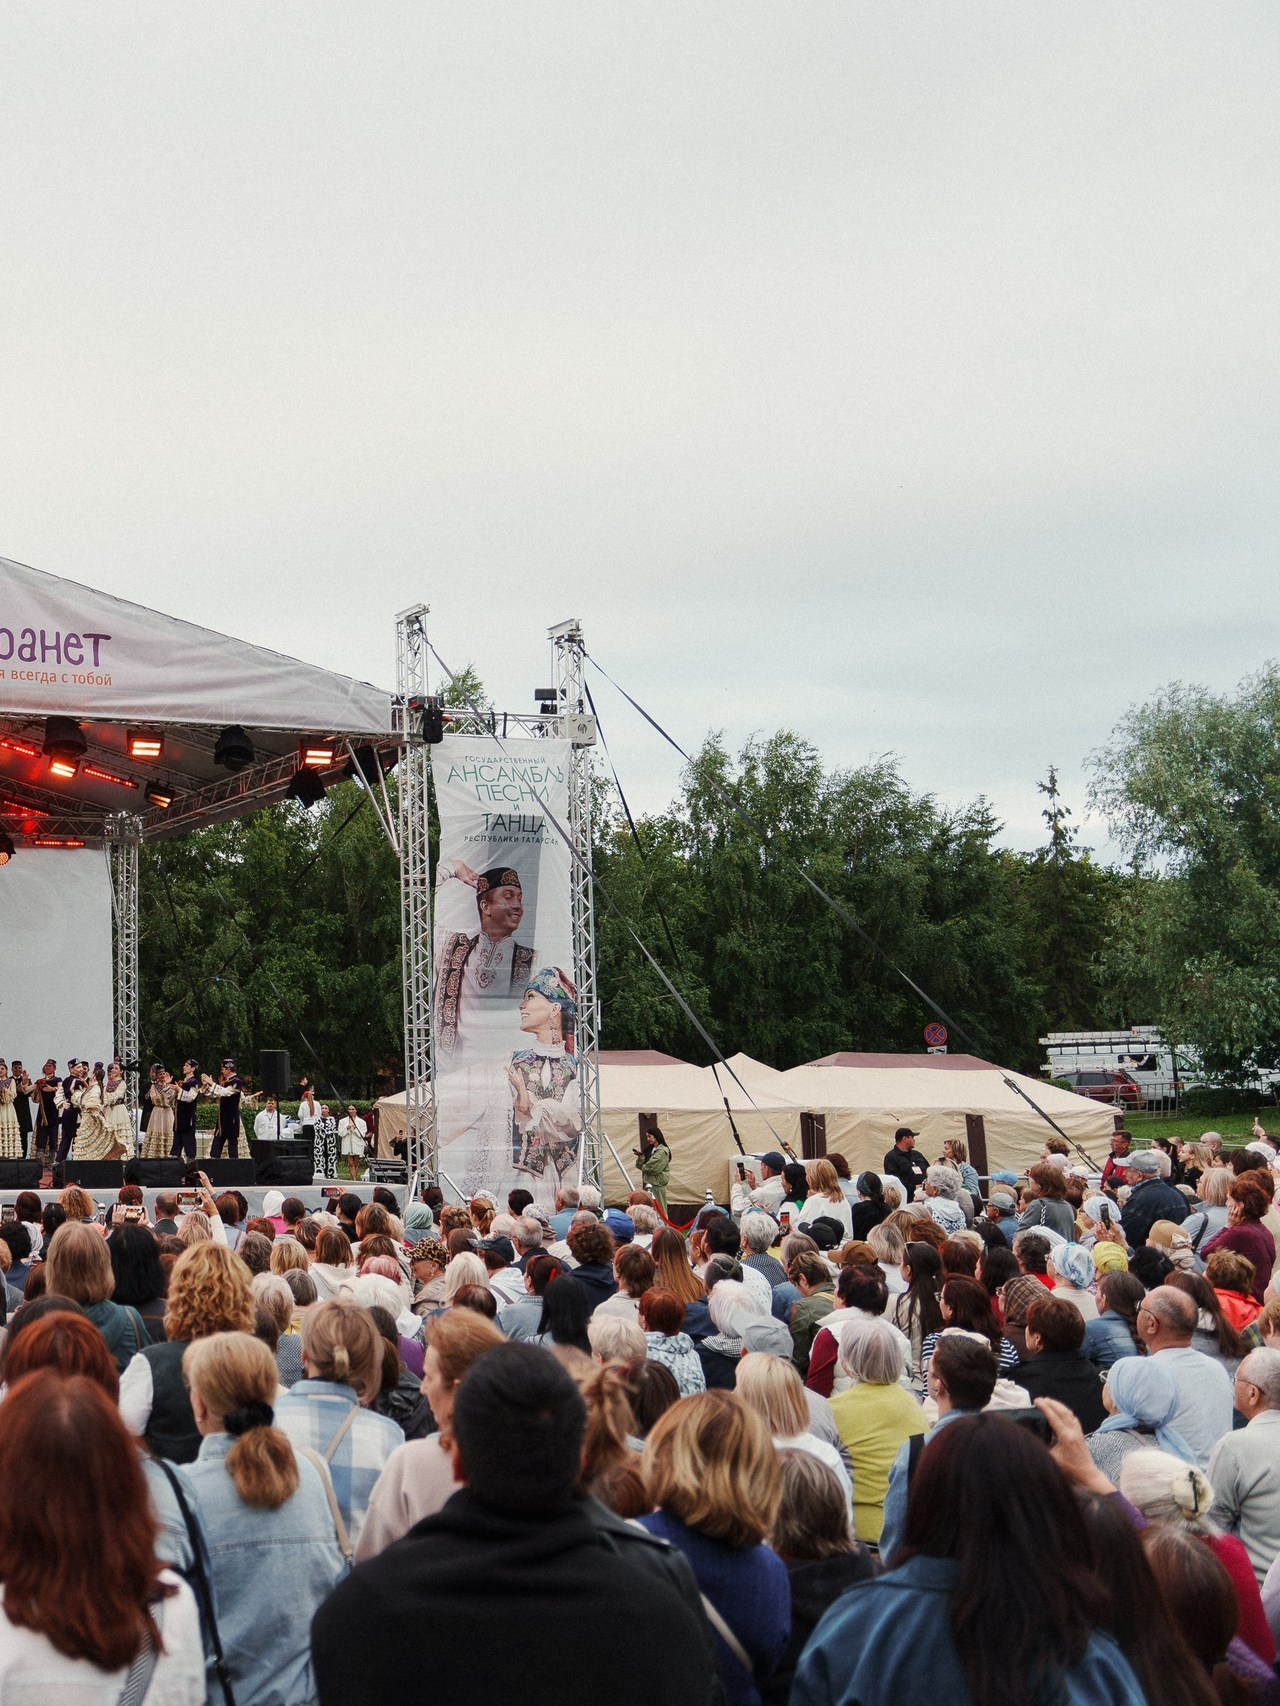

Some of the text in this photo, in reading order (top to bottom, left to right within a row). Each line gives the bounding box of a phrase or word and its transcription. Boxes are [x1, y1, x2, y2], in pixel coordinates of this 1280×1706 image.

[11, 669, 57, 684] всегда
[61, 673, 69, 684] с
[72, 672, 112, 686] тобой
[464, 755, 546, 764] ГОСУДАРСТВЕННЫЙ
[447, 764, 564, 784] АНСАМБЛЬ
[475, 784, 549, 802] ПЕСНИ
[481, 813, 549, 836] ТАНЦА
[464, 835, 519, 844] РЕСПУБЛИКИ
